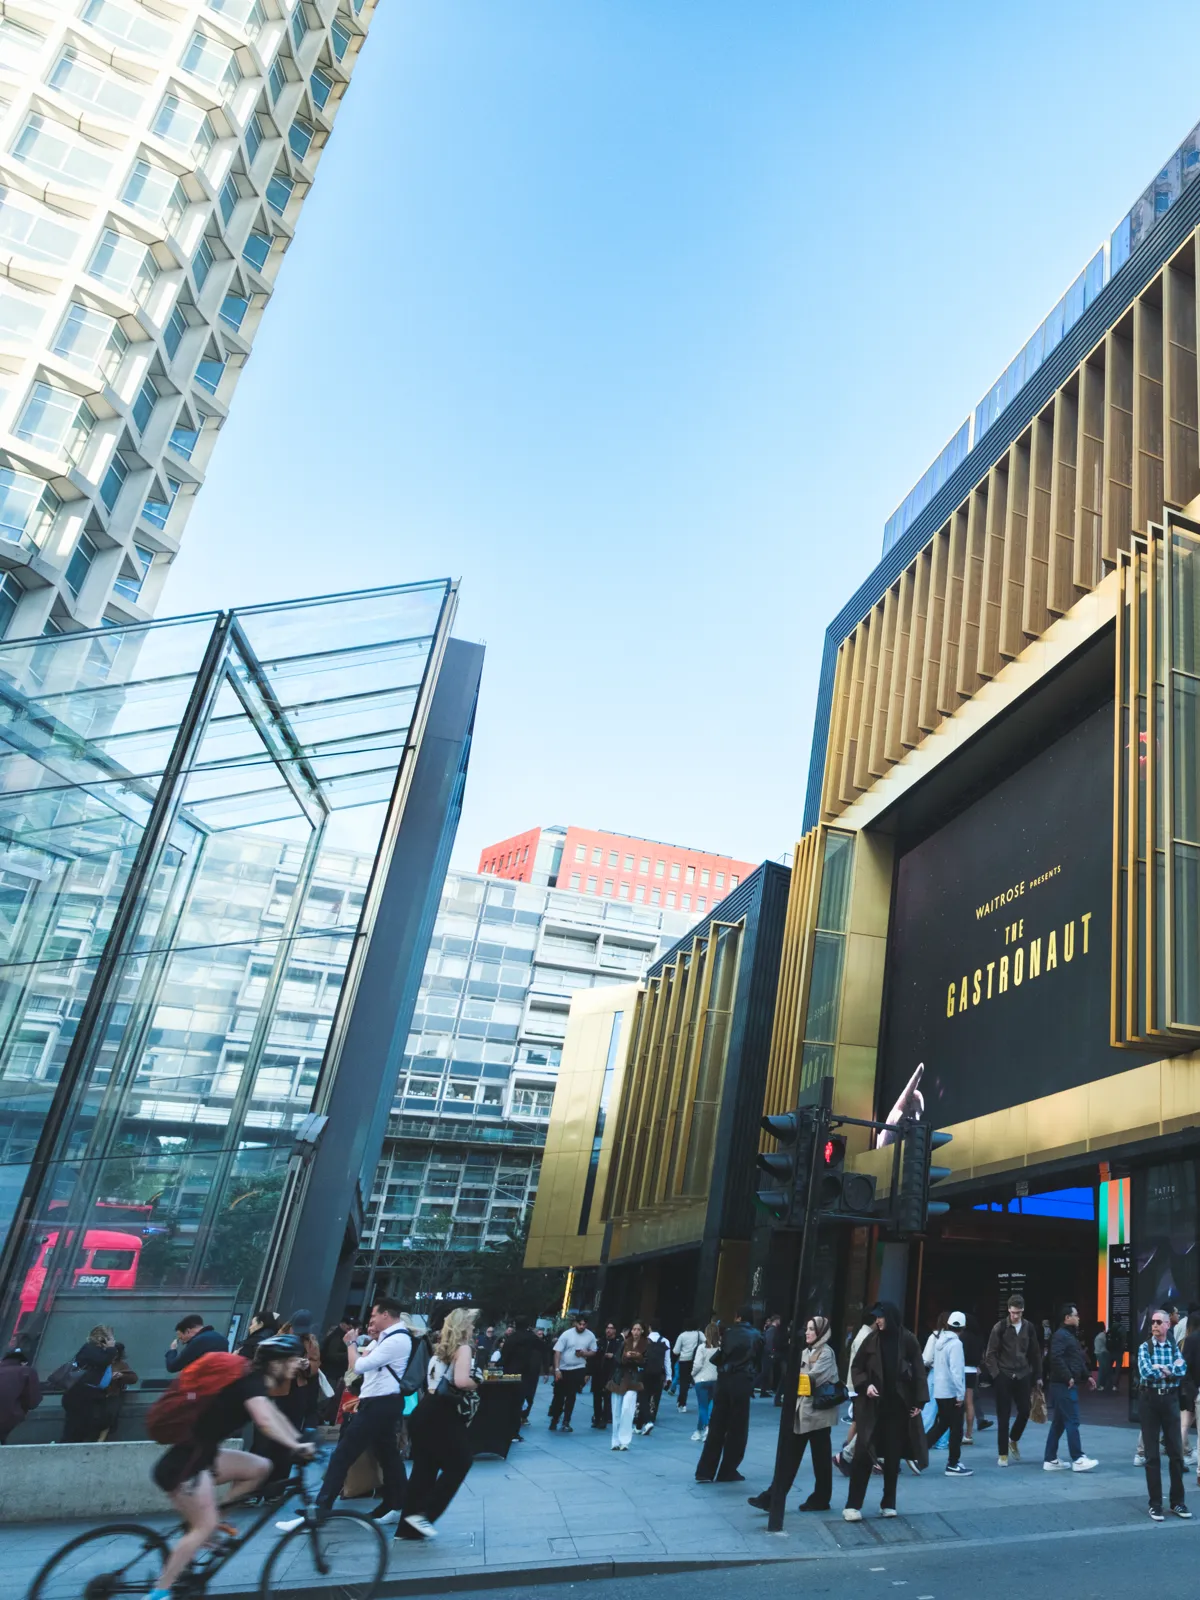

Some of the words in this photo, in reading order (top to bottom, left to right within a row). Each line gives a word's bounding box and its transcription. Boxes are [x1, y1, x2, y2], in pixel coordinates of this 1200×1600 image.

[976, 881, 1025, 920] WAITROSE
[1030, 865, 1061, 889] PRESENTS
[1005, 919, 1024, 945] THE
[947, 912, 1092, 1018] GASTRONAUT
[79, 1276, 107, 1284] SNOG
